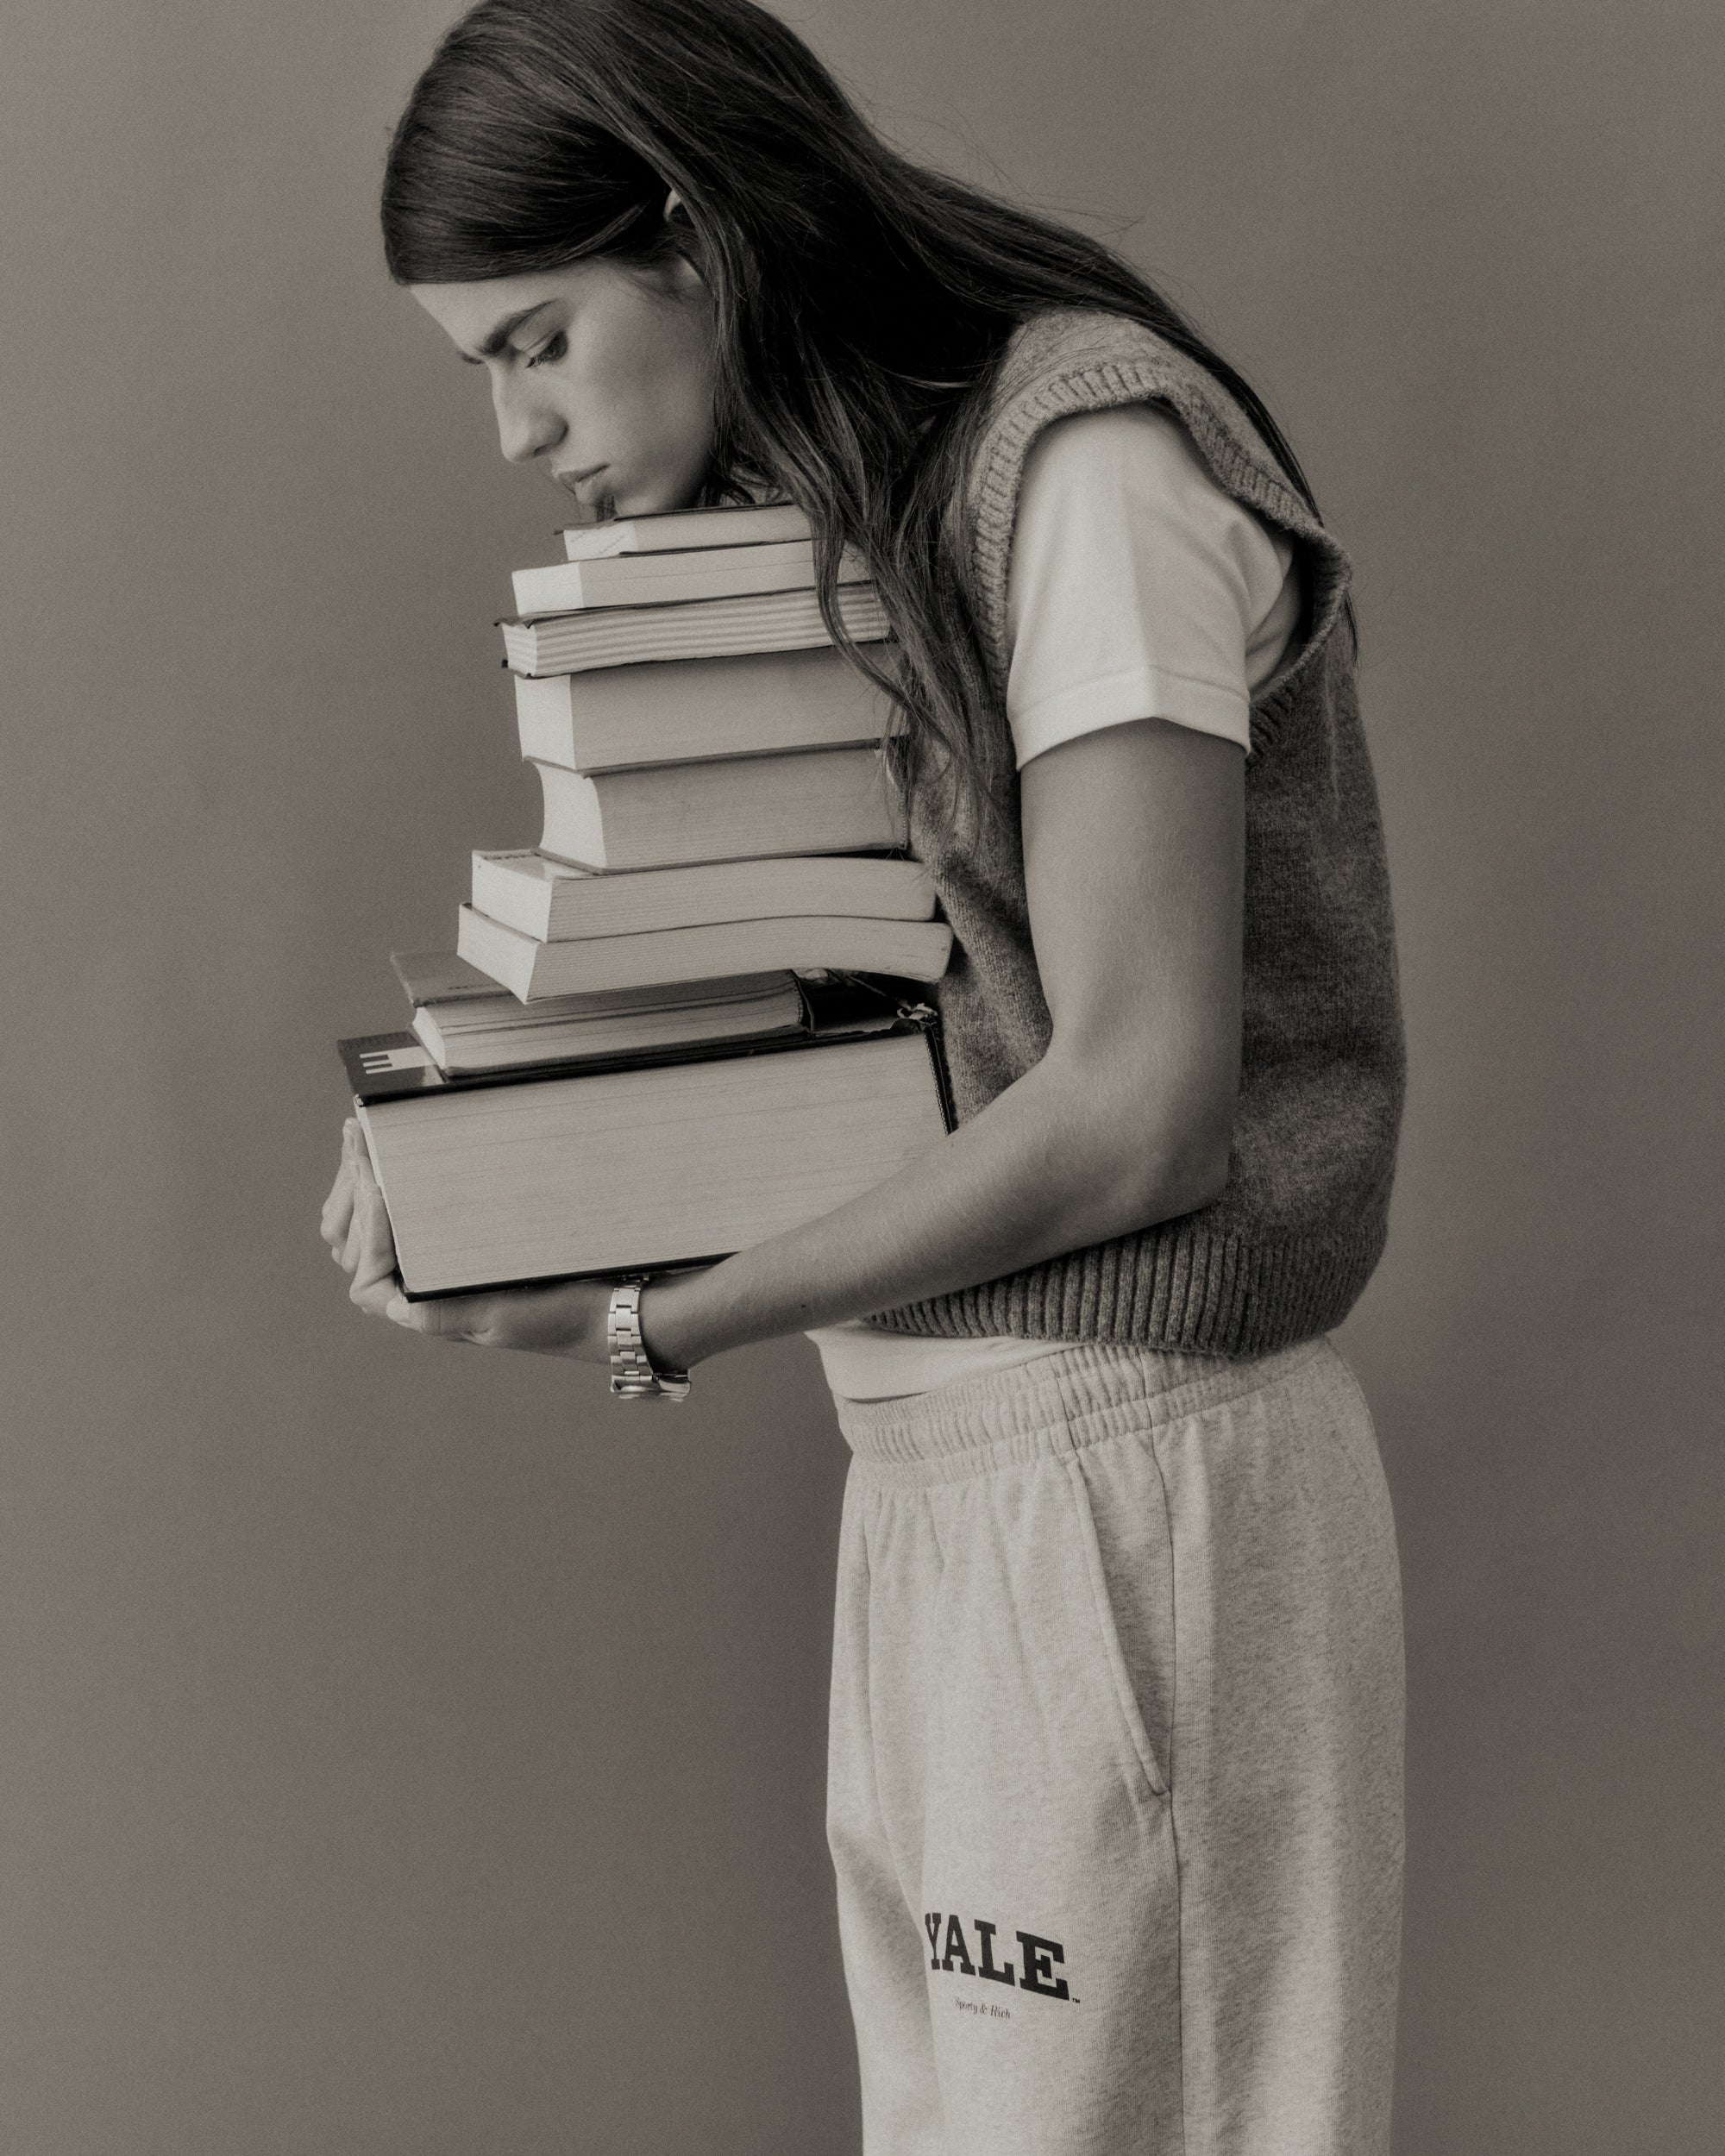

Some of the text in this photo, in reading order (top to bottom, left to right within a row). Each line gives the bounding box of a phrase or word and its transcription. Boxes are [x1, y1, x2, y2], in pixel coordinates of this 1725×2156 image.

[925, 1912, 1070, 2001] YALE
[953, 1996, 1011, 2019] Sporty & Rich
